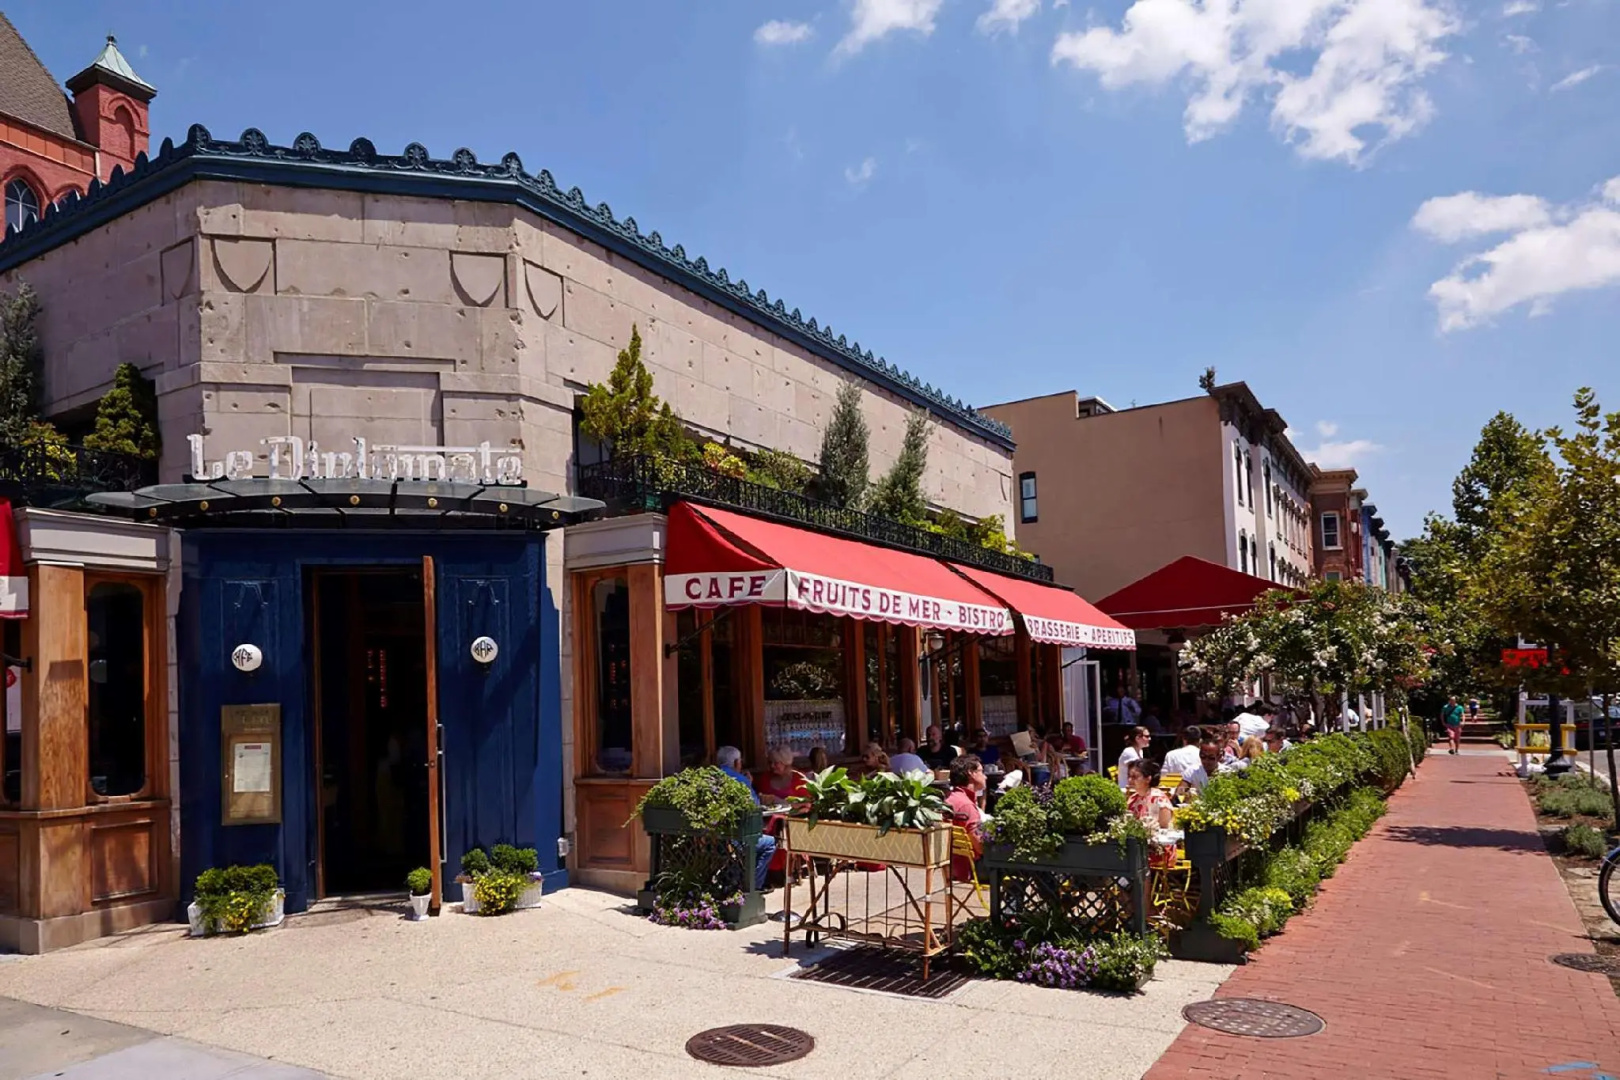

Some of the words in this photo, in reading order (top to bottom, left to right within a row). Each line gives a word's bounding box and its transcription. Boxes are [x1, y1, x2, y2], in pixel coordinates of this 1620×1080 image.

[187, 434, 253, 480] Le
[684, 575, 767, 601] CAFE
[797, 576, 871, 611] FRUITS
[879, 592, 902, 615] DE
[908, 596, 941, 621] MER
[958, 605, 1005, 629] BISTRO
[1027, 618, 1080, 640] BRASSERIE
[1091, 627, 1135, 645] APERITIFS
